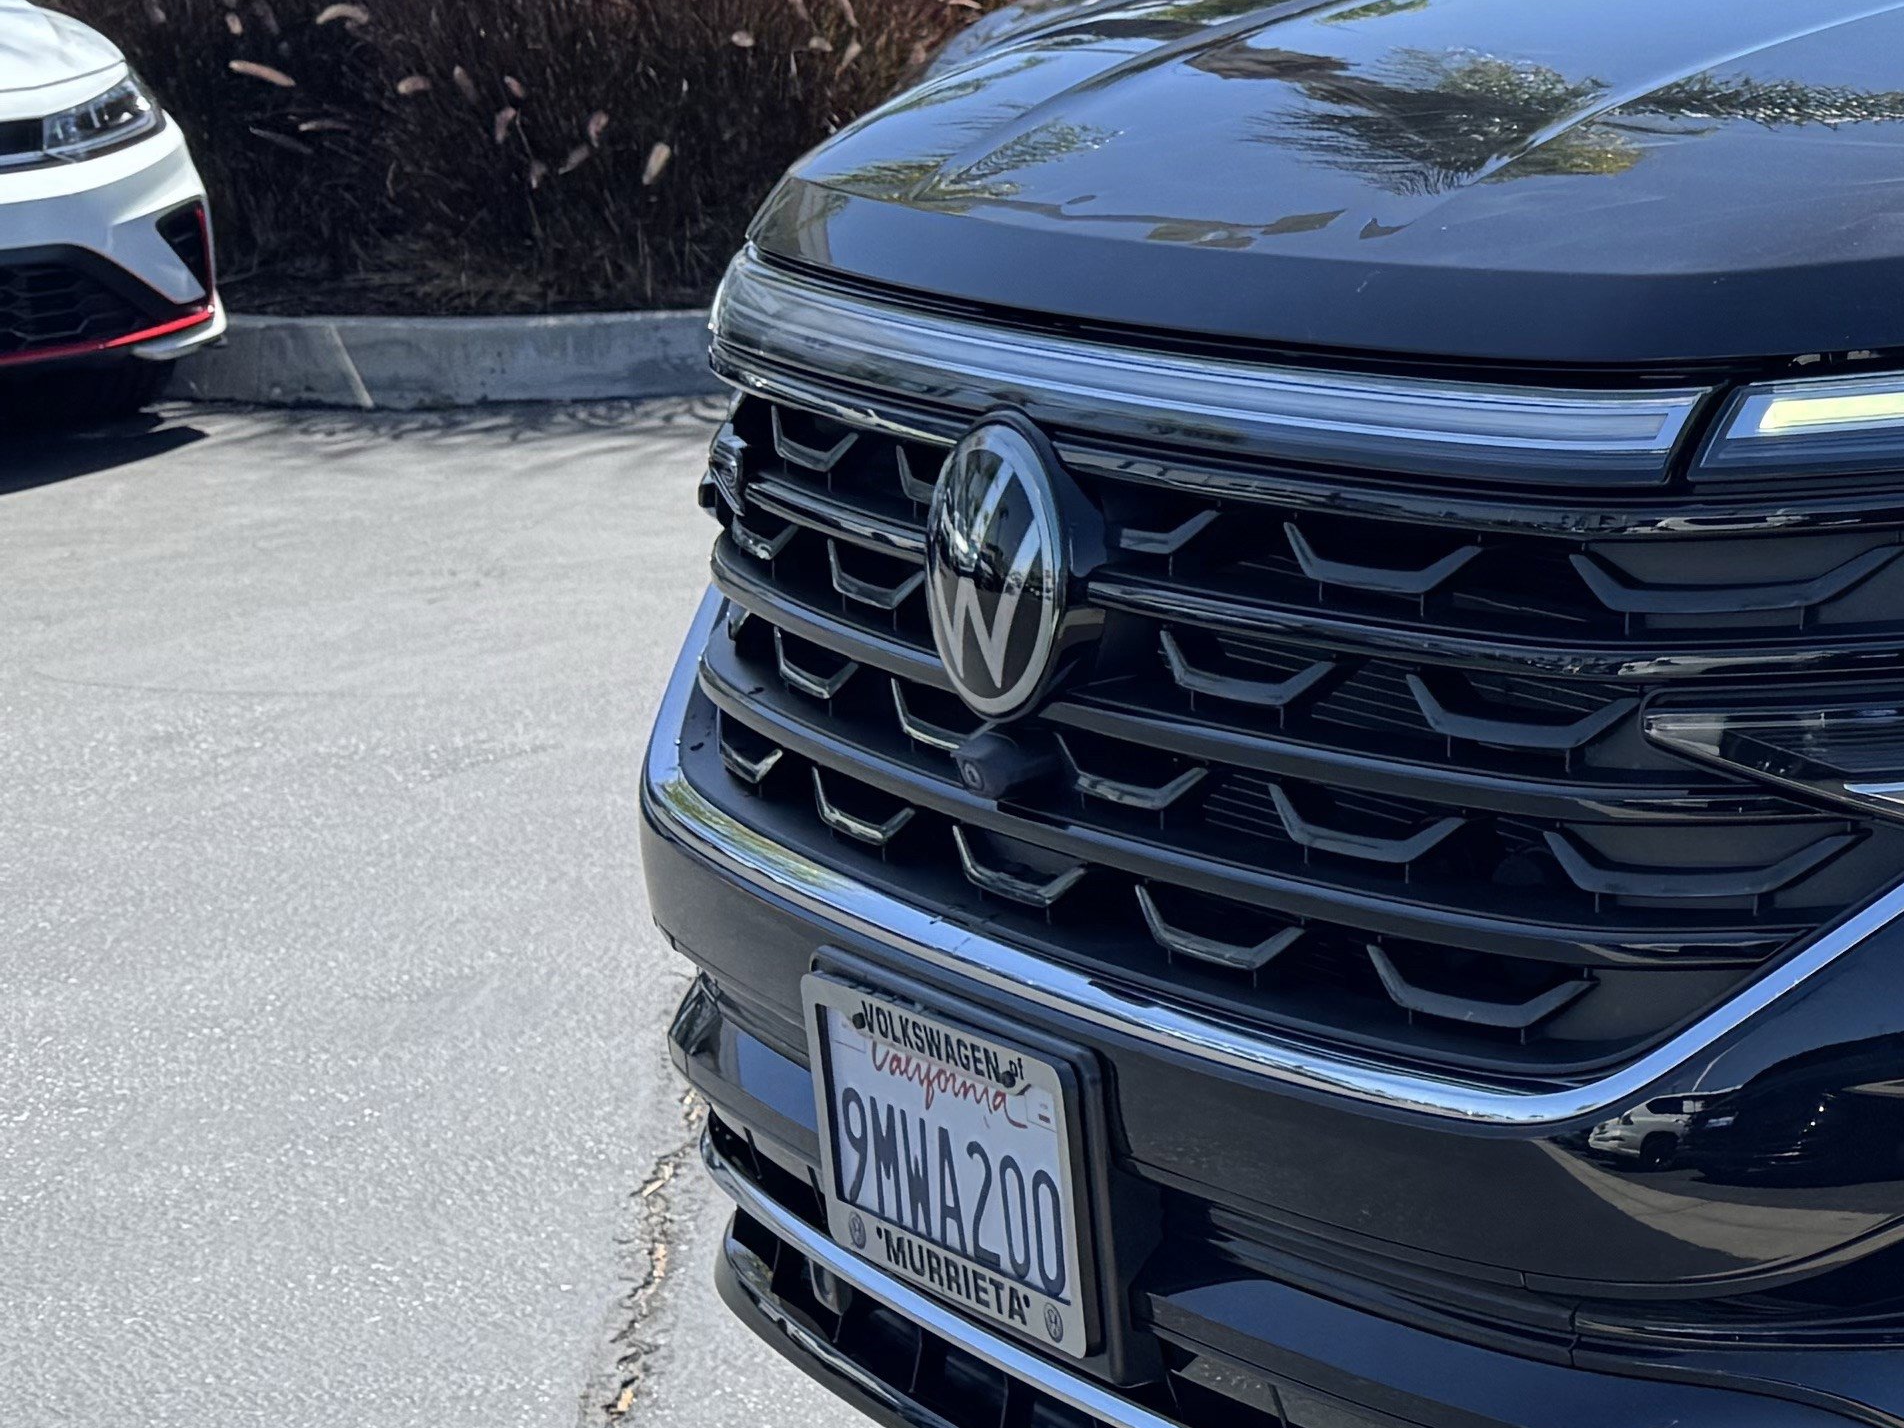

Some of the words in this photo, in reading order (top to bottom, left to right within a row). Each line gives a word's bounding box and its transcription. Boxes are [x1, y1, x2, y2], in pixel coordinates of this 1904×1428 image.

[861, 1000, 1002, 1082] VOLKSWAGEN
[841, 1086, 1065, 1299] 9MWA200
[884, 1235, 1028, 1326] MURRIETA
